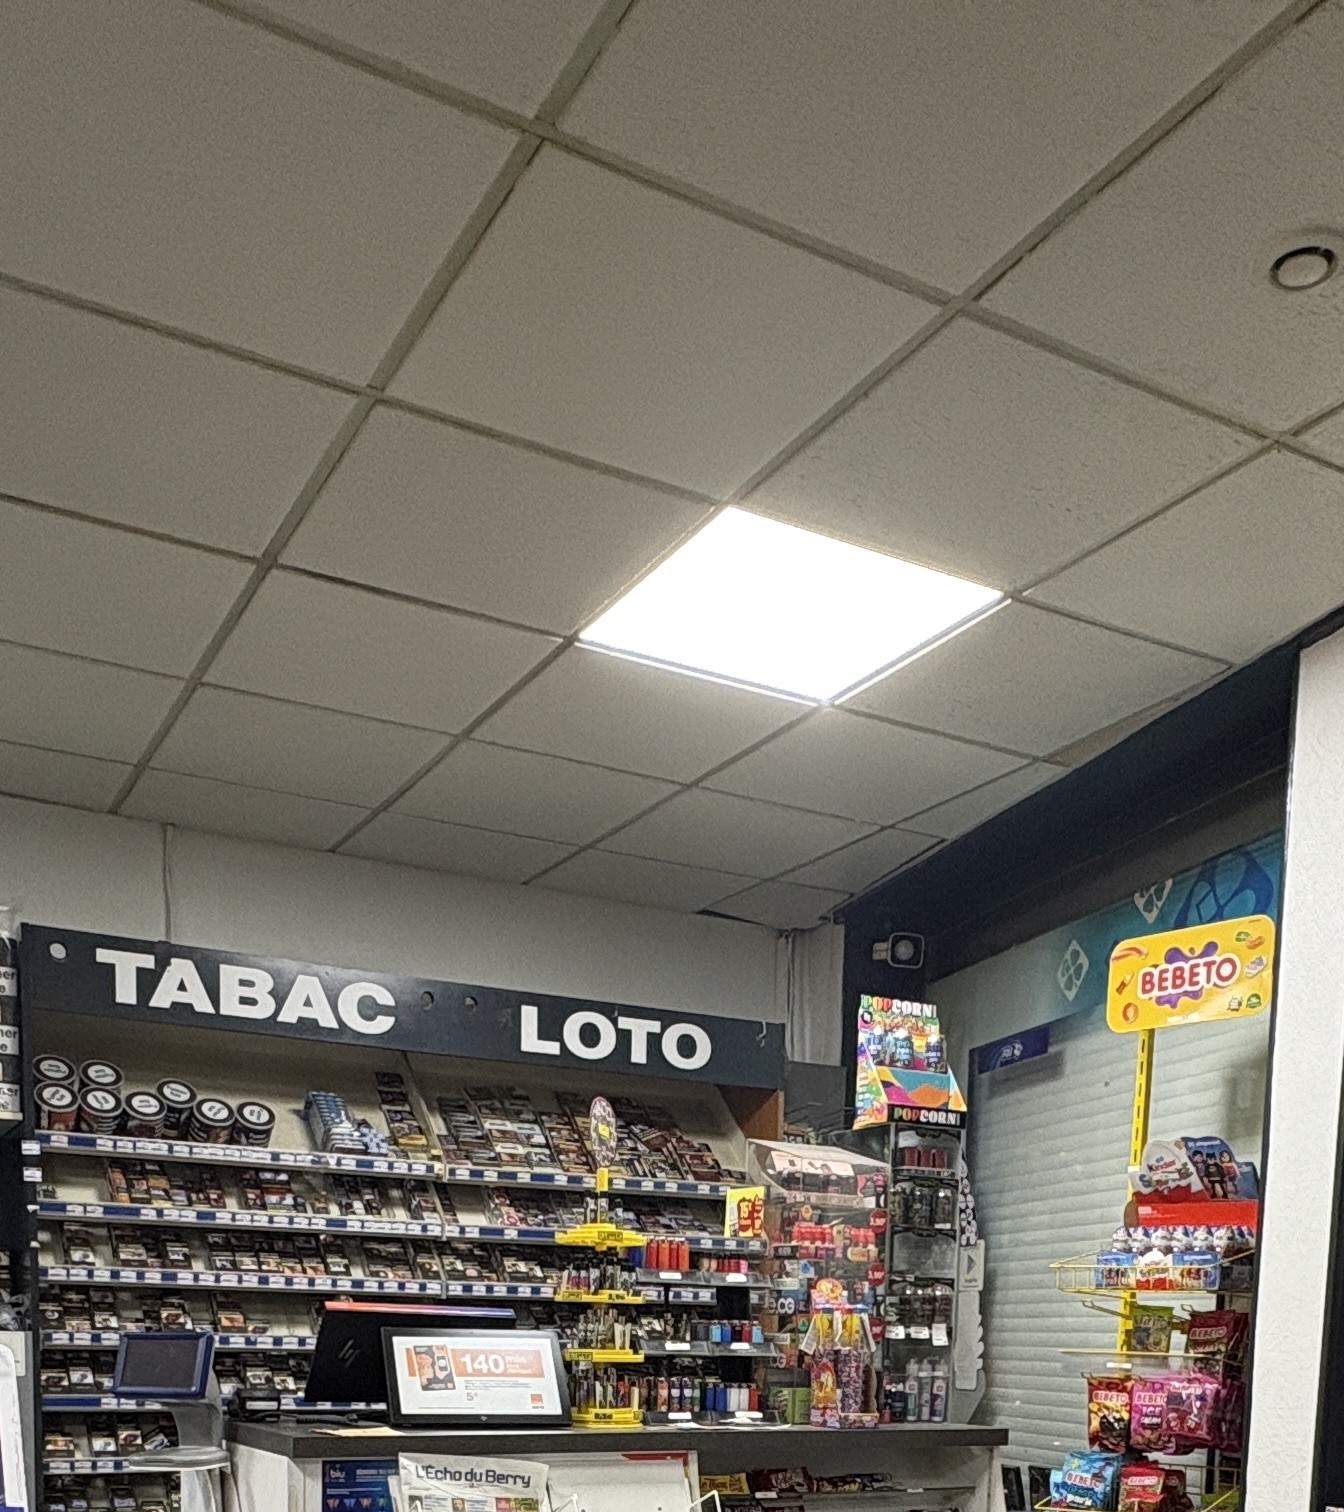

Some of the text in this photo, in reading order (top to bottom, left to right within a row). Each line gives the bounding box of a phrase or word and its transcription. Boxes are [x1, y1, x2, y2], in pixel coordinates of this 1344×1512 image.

[1141, 957, 1237, 996] BEBETO
[96, 947, 712, 1070] TABAC LOTO
[461, 1354, 505, 1374] 140
[1094, 1391, 1128, 1403] BEBETO
[416, 1465, 531, 1488] L'Écho du Berry
